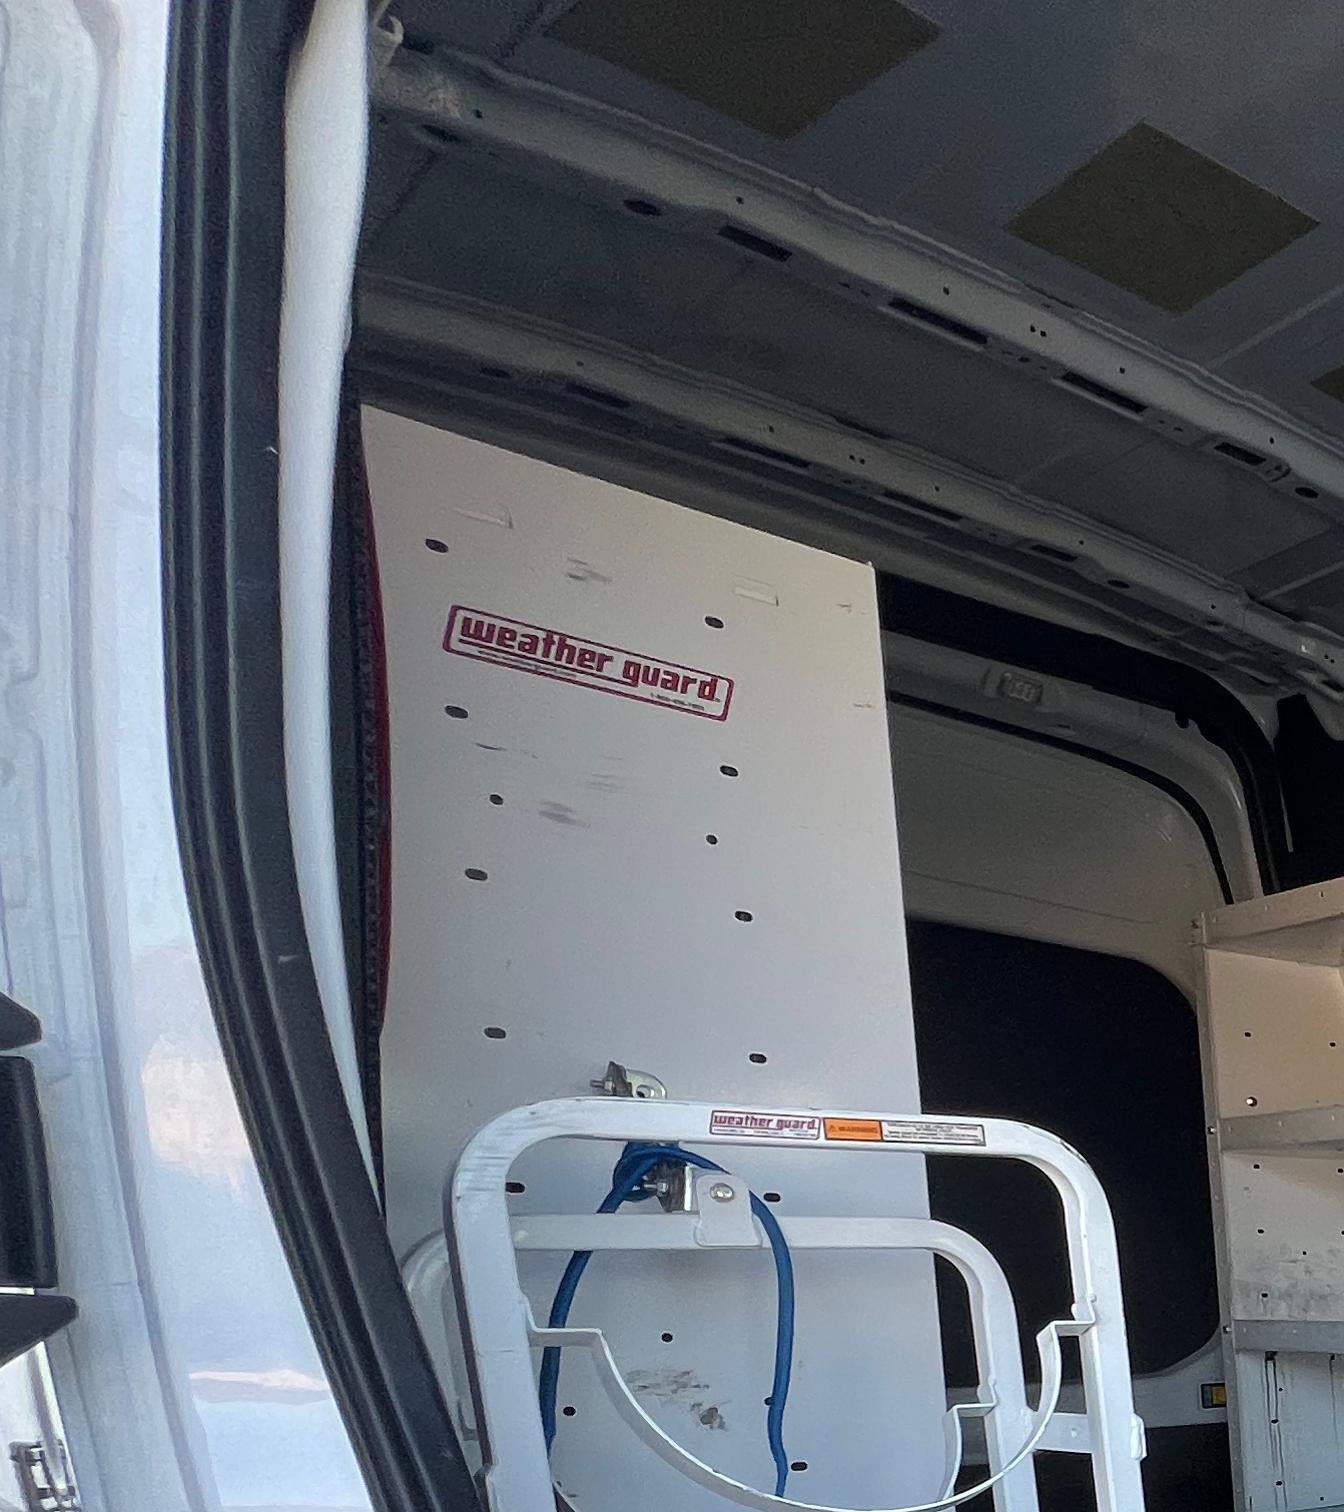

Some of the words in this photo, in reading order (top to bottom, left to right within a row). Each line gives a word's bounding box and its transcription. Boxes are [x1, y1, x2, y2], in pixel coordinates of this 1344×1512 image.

[460, 615, 614, 673] weather
[622, 657, 718, 702] guard
[713, 1115, 774, 1128] weather
[776, 1119, 816, 1130] guard
